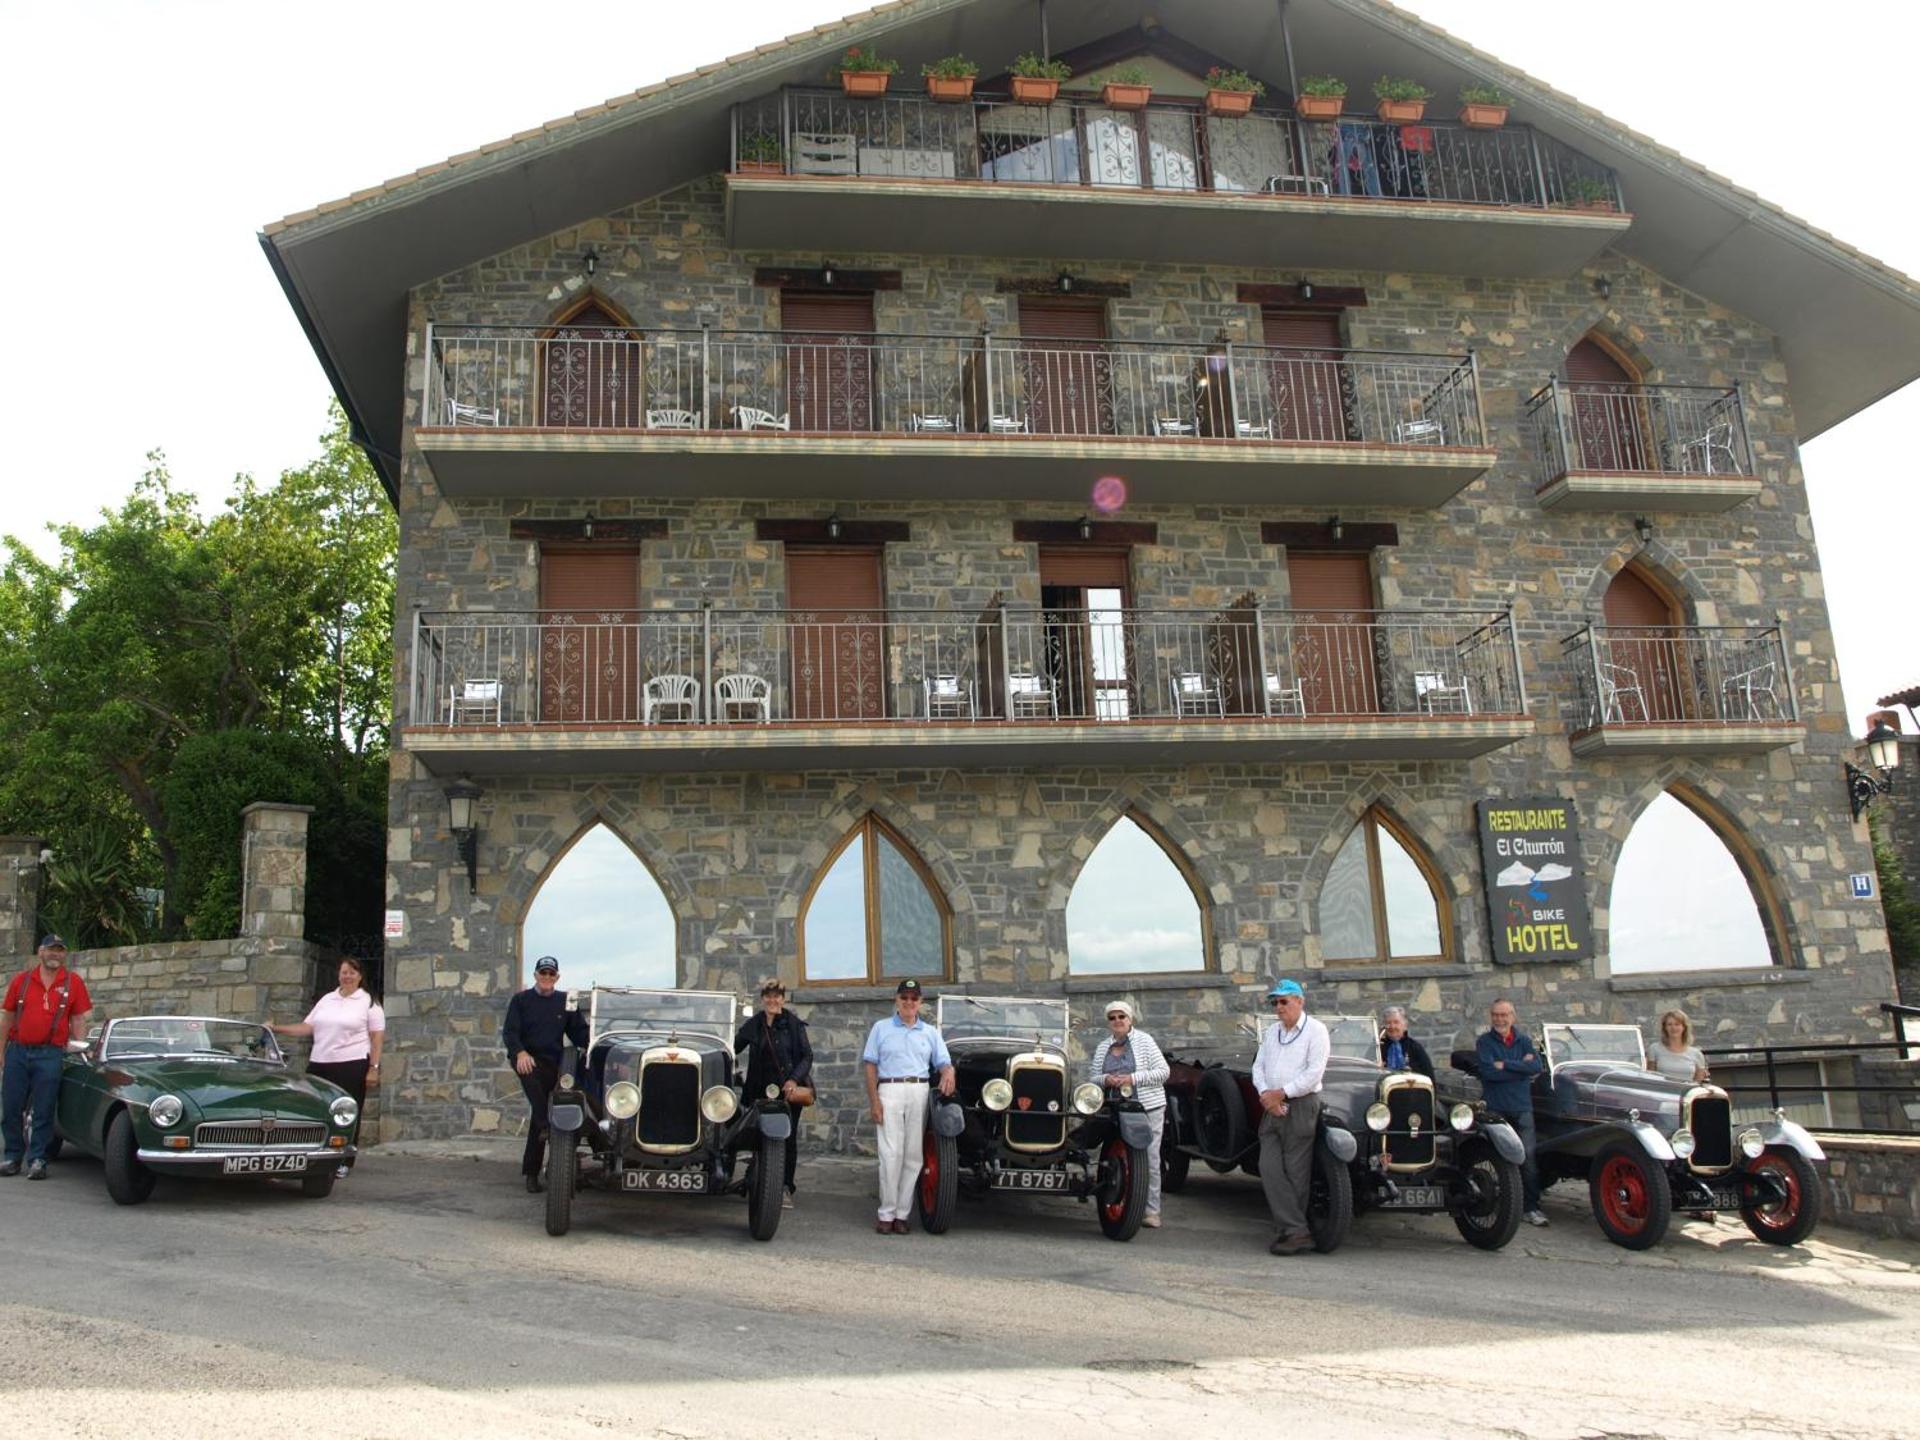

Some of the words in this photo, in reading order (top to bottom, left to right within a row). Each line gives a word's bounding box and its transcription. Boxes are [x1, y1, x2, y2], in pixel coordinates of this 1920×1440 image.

[1488, 809, 1566, 832] RESTAURANTE
[1496, 838, 1511, 856] El
[1513, 837, 1565, 856] Churrón
[1532, 909, 1565, 921] BIKE
[1506, 923, 1579, 953] HOTEL
[227, 1157, 260, 1172] MPG
[263, 1155, 307, 1171] 874D
[626, 1172, 650, 1188] DK
[656, 1173, 704, 1190] 4363
[1021, 1172, 1066, 1188] 8787
